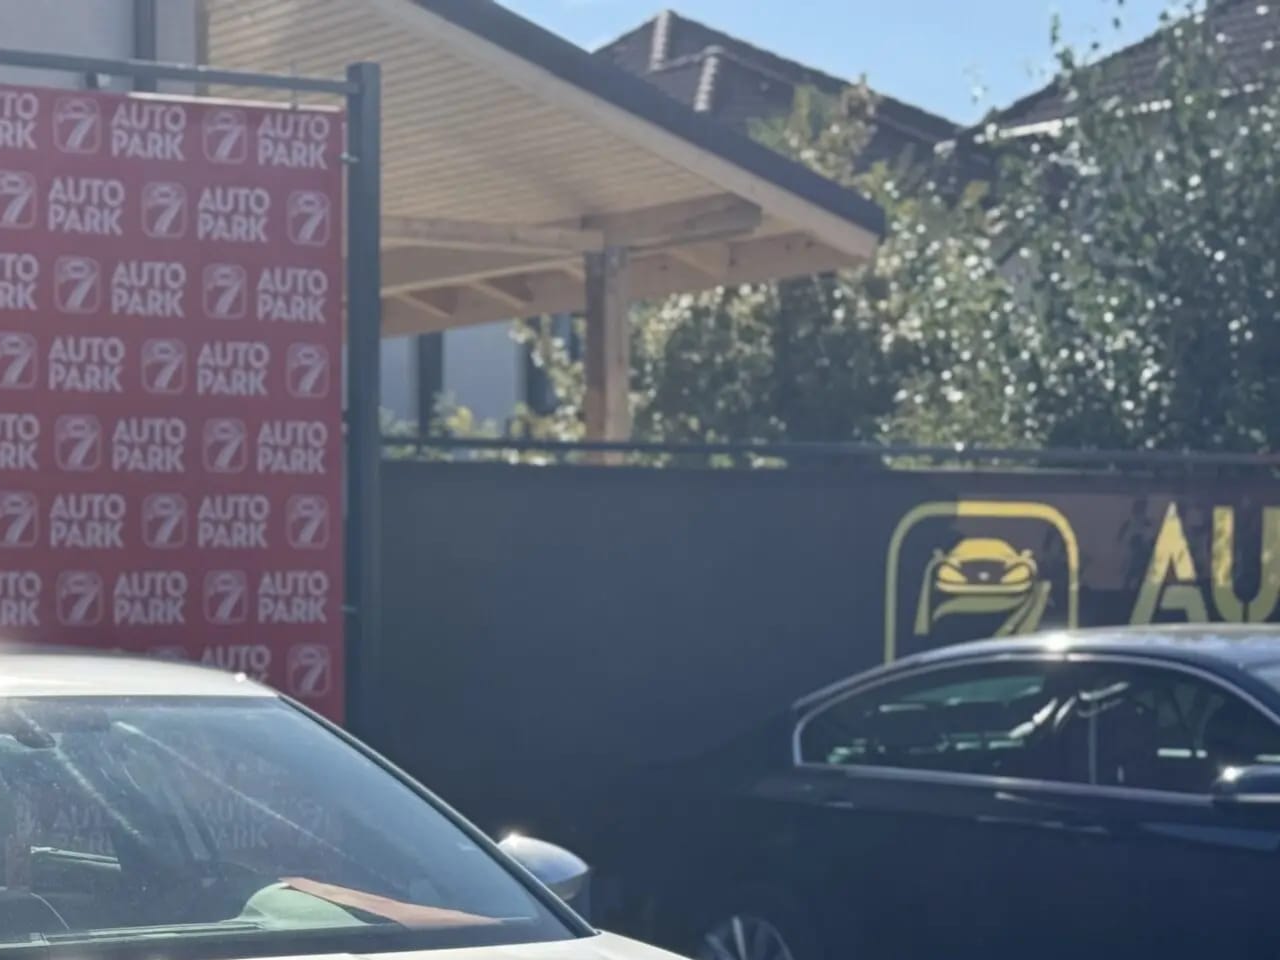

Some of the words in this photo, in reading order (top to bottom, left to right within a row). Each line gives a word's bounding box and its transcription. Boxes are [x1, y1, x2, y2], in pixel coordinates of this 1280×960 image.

[111, 104, 187, 133] AUTO
[256, 114, 330, 141] AUTO
[112, 129, 184, 160] PARK
[258, 137, 327, 169] PARK
[48, 177, 125, 207] AUTO
[198, 187, 270, 215] AUTO
[48, 203, 122, 235] PARK
[197, 211, 267, 242] PARK
[112, 261, 186, 289] AUTO
[257, 268, 328, 296] AUTO
[112, 288, 183, 317] PARK
[257, 292, 325, 323] PARK
[49, 337, 125, 364] AUTO
[197, 342, 270, 369] AUTO
[49, 363, 122, 392] PARK
[197, 368, 267, 396] PARK
[112, 418, 186, 445] AUTO
[257, 421, 328, 447] AUTO
[112, 444, 184, 472] PARK
[257, 446, 325, 474] PARK
[50, 494, 126, 521] AUTO
[198, 494, 270, 522] AUTO
[50, 520, 123, 548] PARK
[198, 521, 267, 548] PARK
[114, 571, 188, 598] AUTO
[258, 571, 329, 597] AUTO
[114, 597, 185, 625] PARK
[258, 596, 326, 623] PARK
